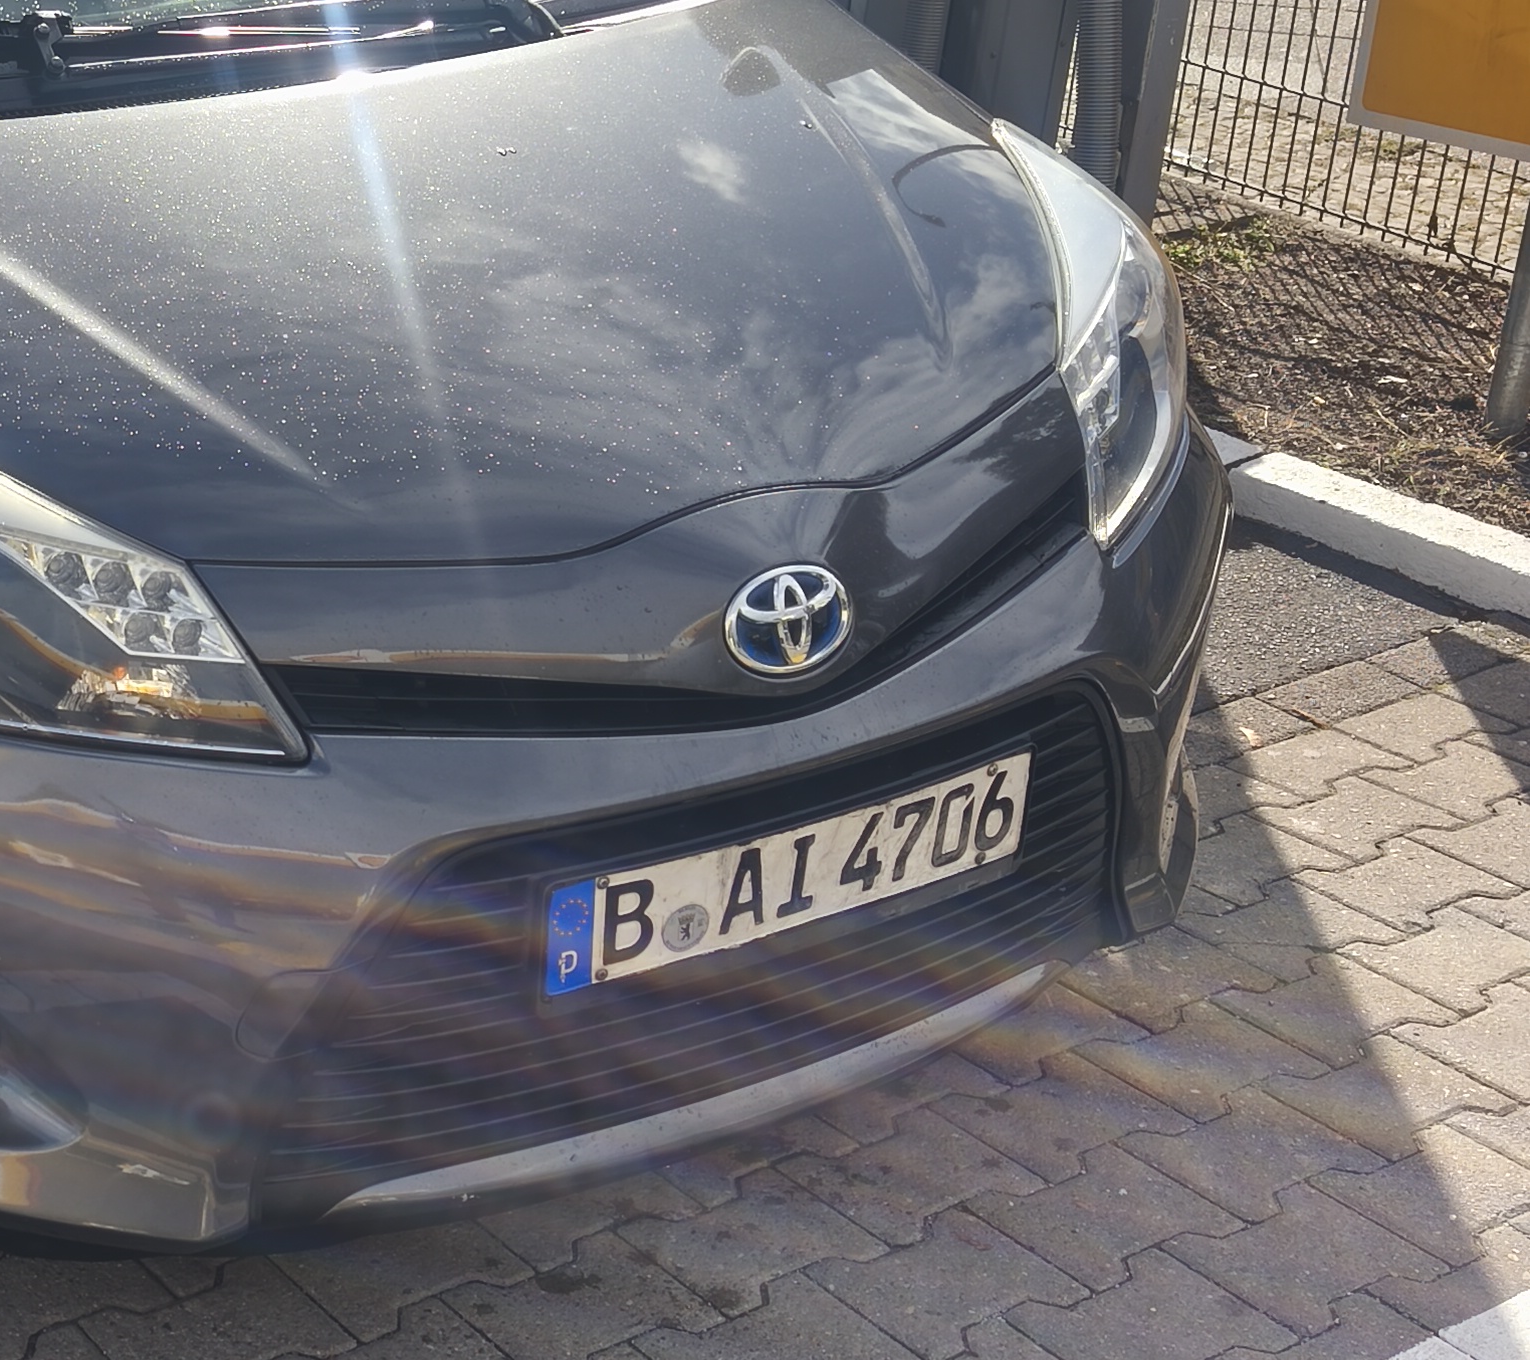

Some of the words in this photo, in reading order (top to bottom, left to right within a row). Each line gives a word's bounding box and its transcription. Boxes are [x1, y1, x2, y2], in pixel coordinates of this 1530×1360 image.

[603, 878, 654, 966] B
[719, 834, 816, 935] AI
[839, 770, 1014, 892] 4706
